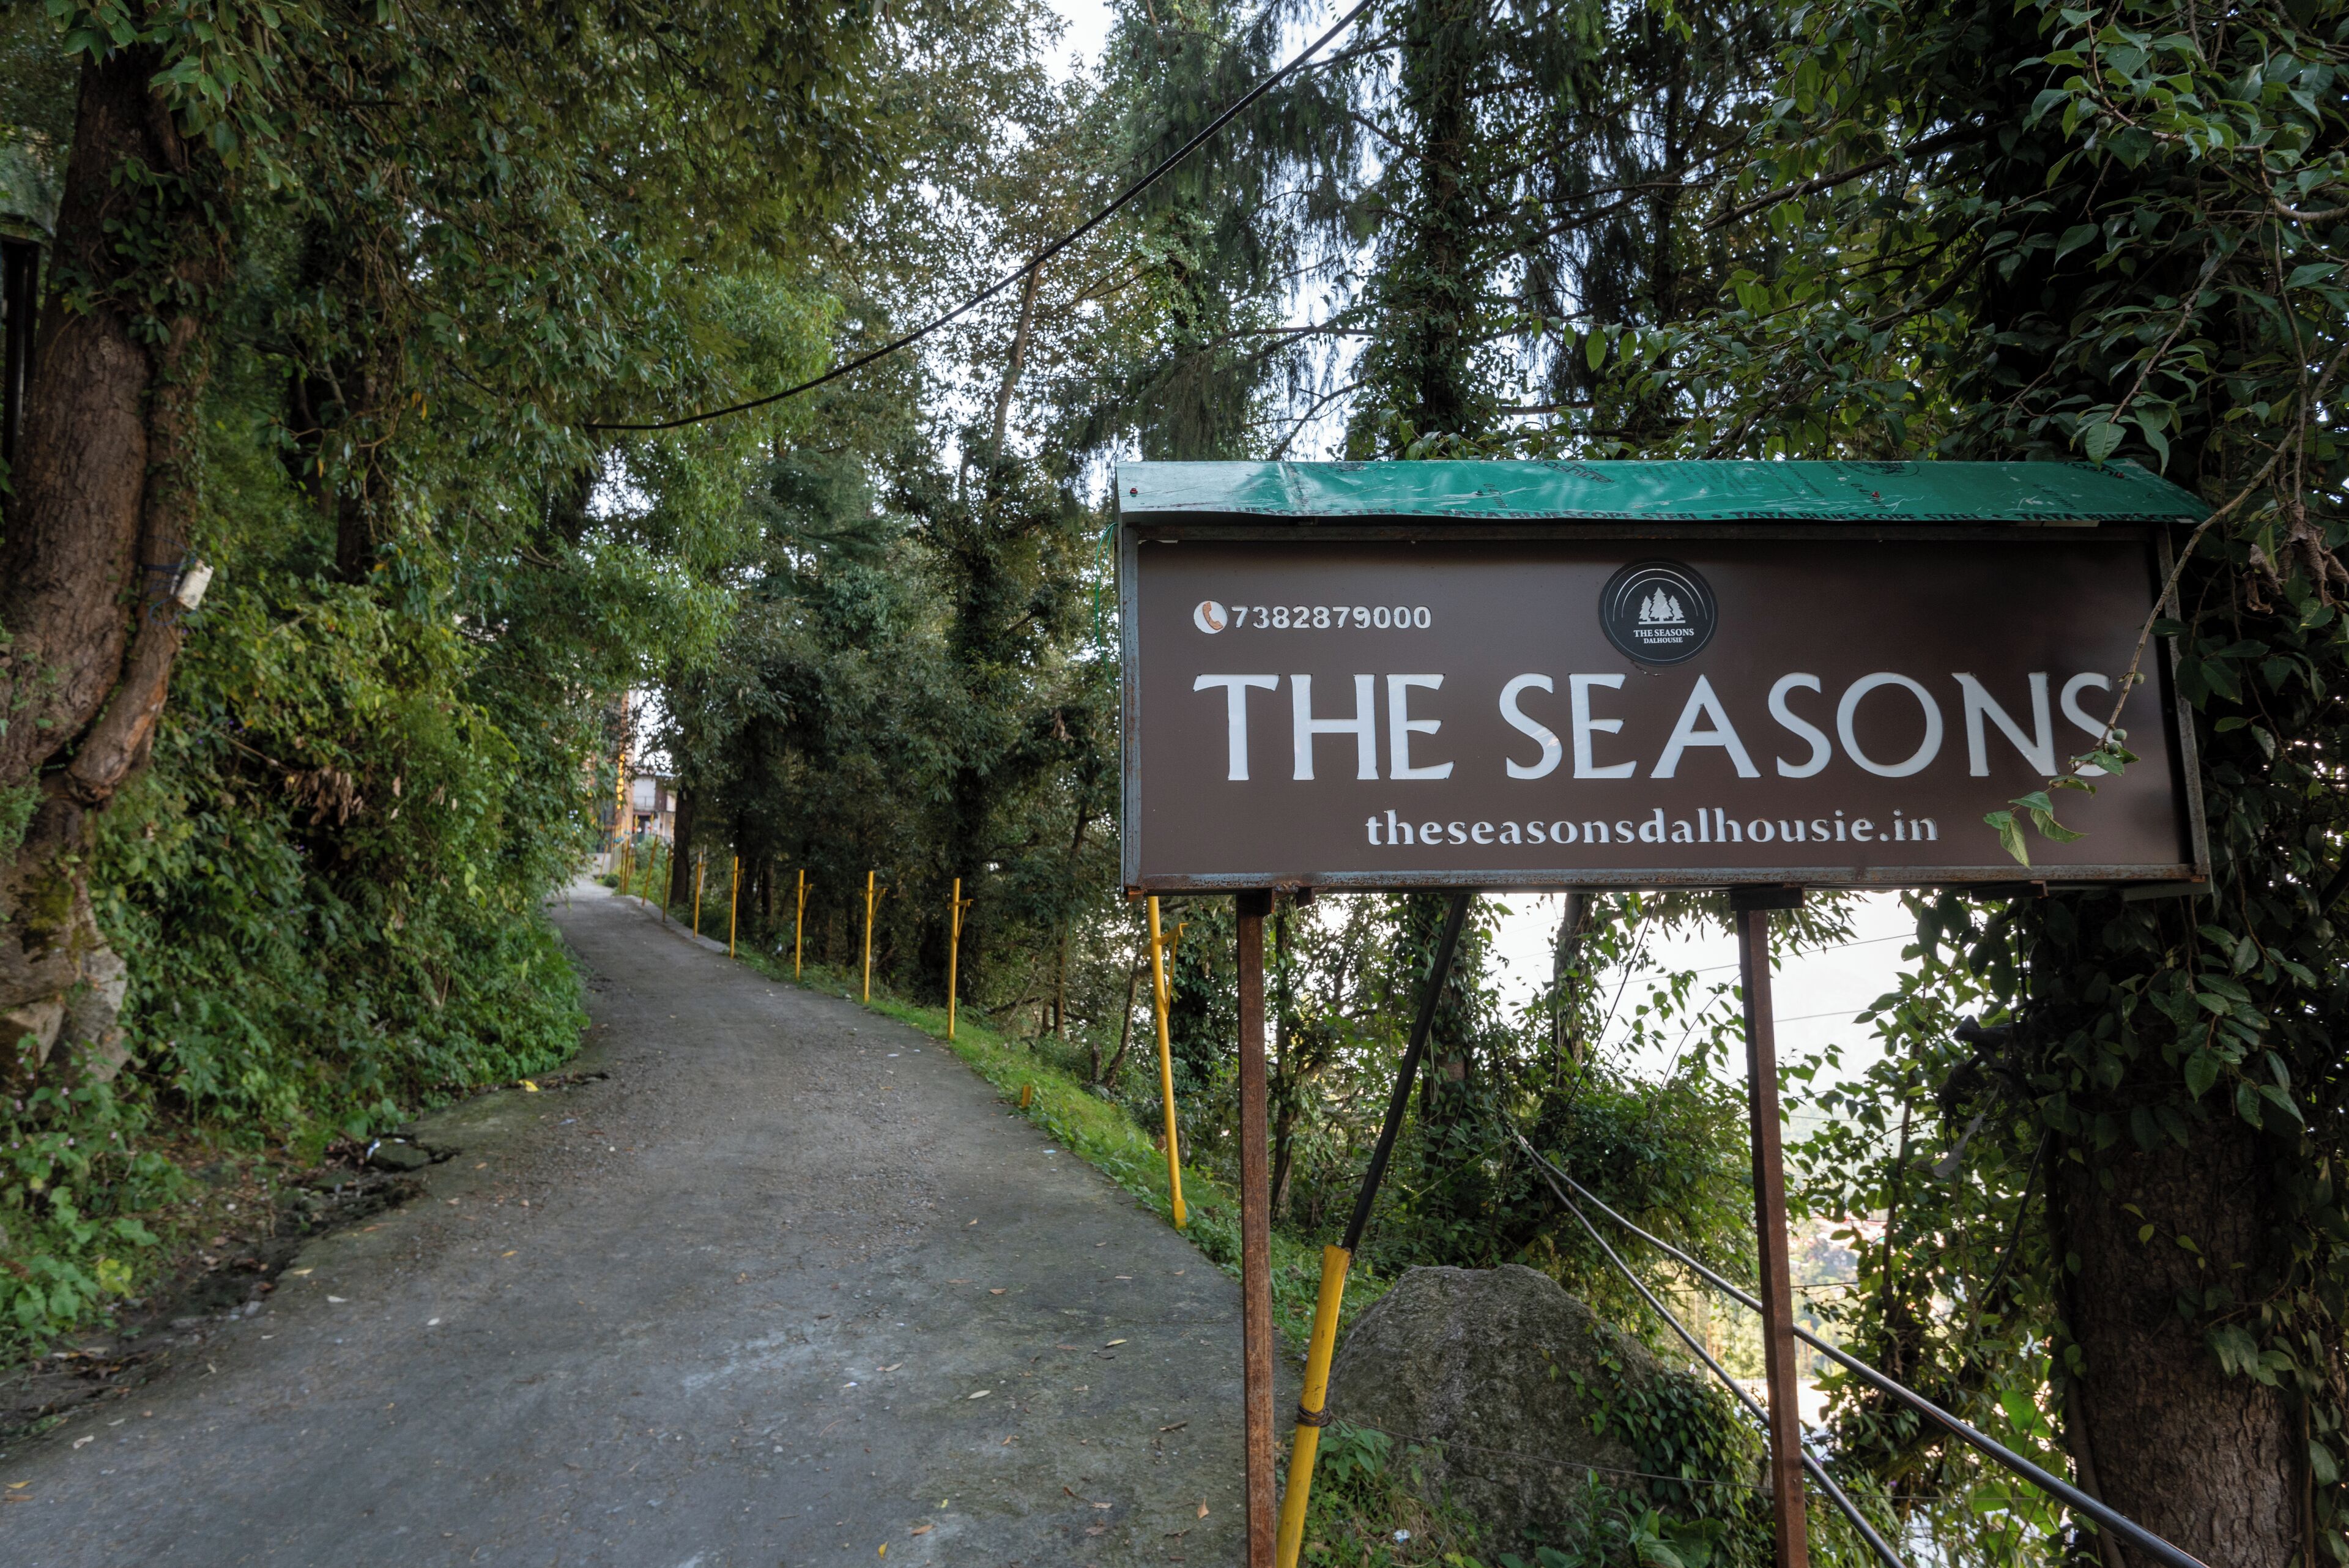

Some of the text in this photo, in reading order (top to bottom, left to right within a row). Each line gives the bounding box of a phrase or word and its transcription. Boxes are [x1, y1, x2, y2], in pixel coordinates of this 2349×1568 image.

[1231, 606, 1431, 629] 7382879000
[1654, 628, 1694, 637] SEASONS
[1193, 672, 2123, 781] THE SEASONS
[1365, 807, 1939, 845] theseasonsdalhousie.in
